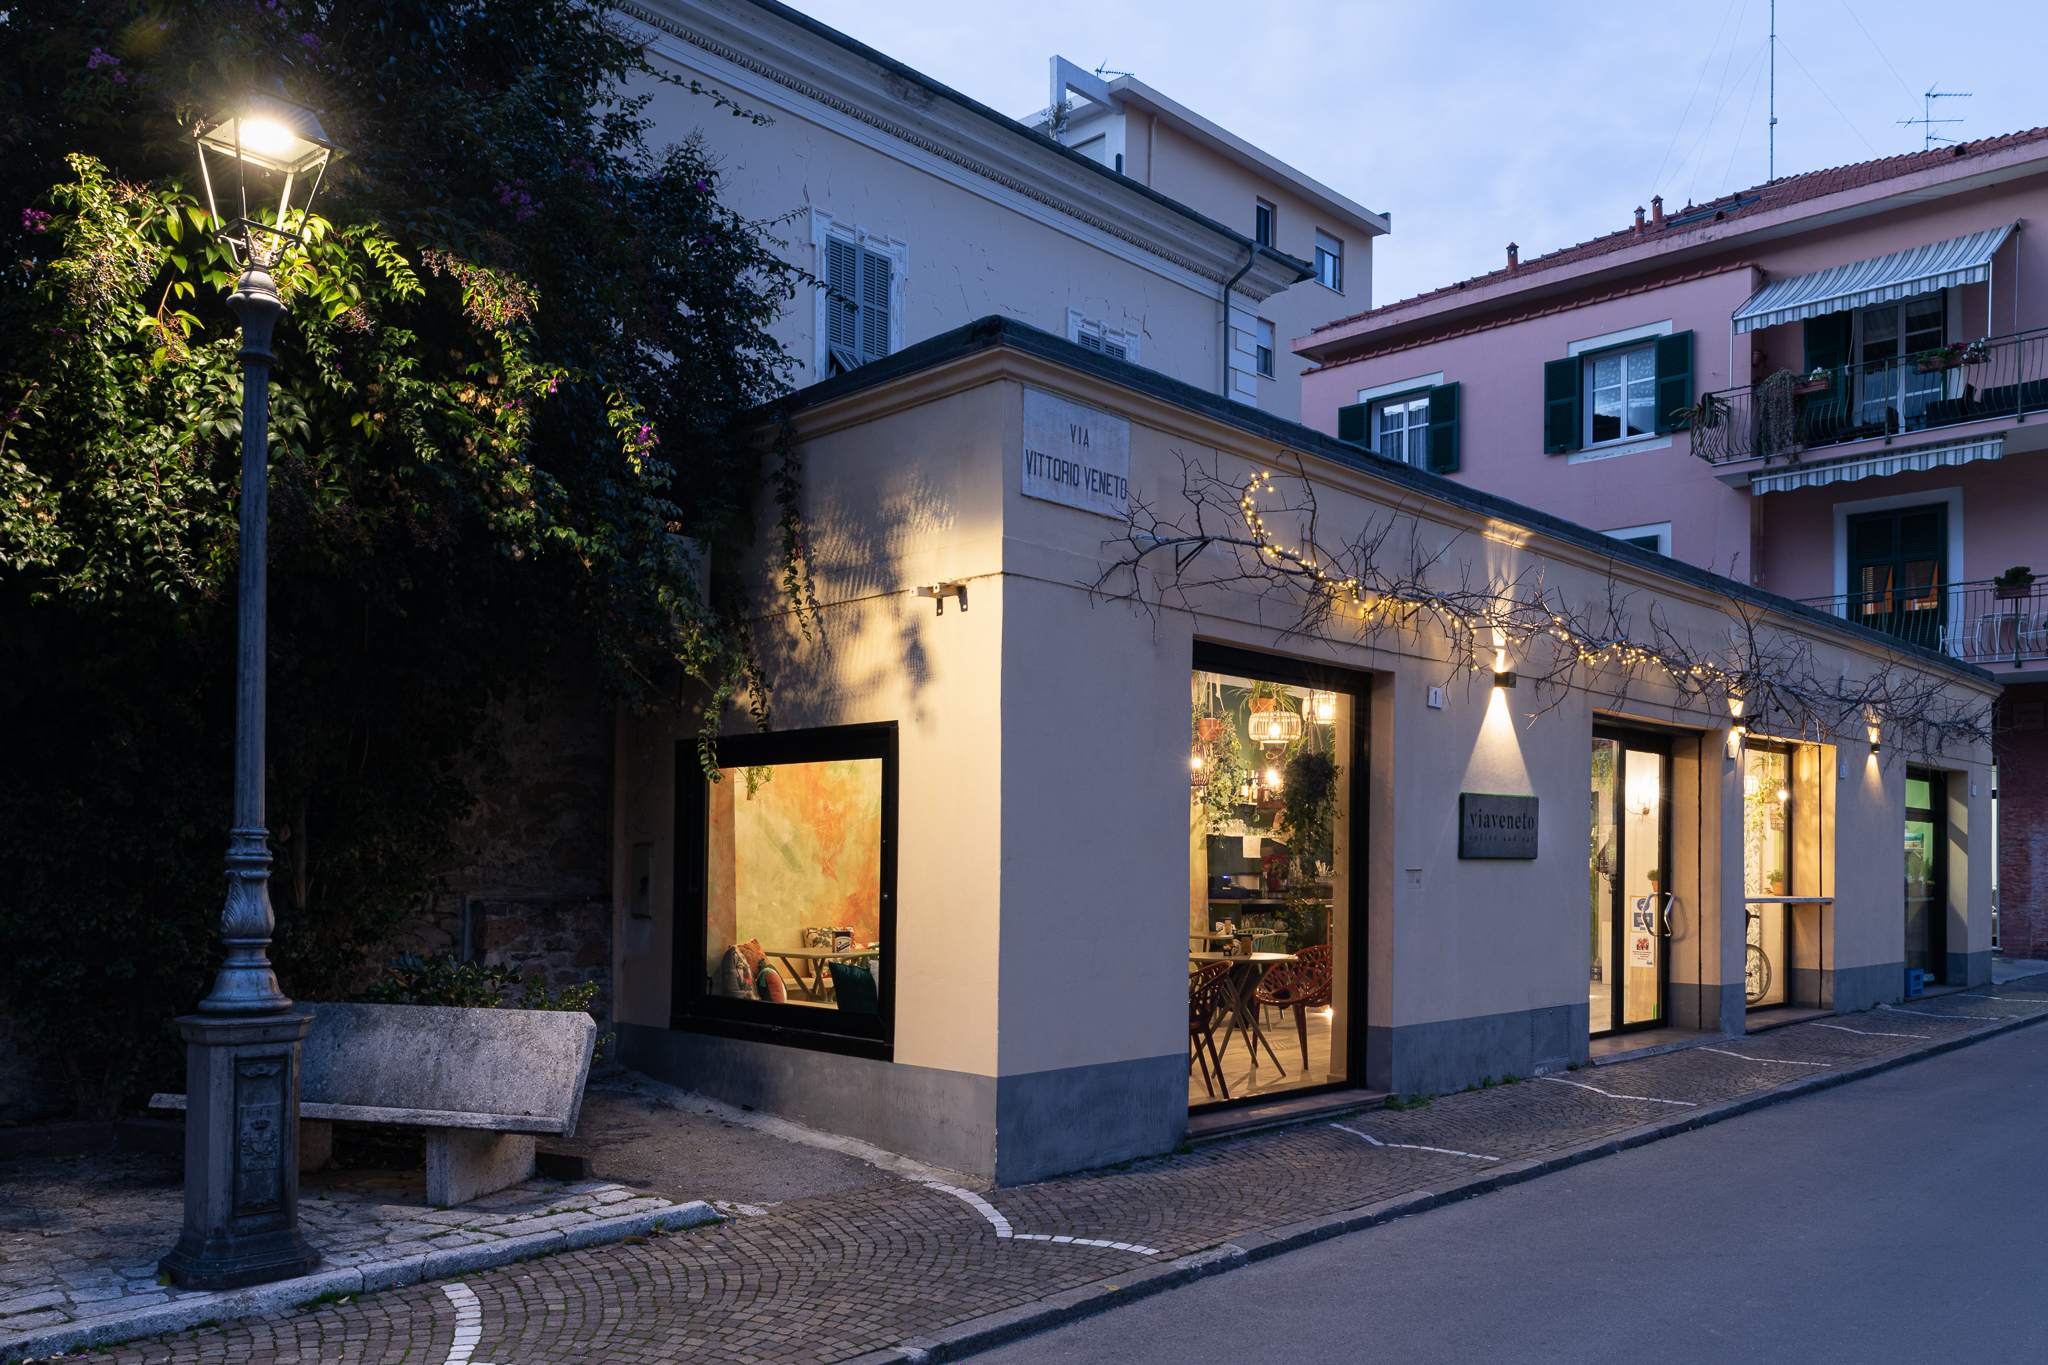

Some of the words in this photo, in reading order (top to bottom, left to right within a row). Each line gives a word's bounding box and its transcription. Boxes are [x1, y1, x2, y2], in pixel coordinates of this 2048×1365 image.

[1070, 423, 1089, 448] VIA
[1025, 449, 1080, 487] VITTORIO
[1084, 466, 1128, 500] VENETO
[1469, 808, 1535, 830] viaveneto
